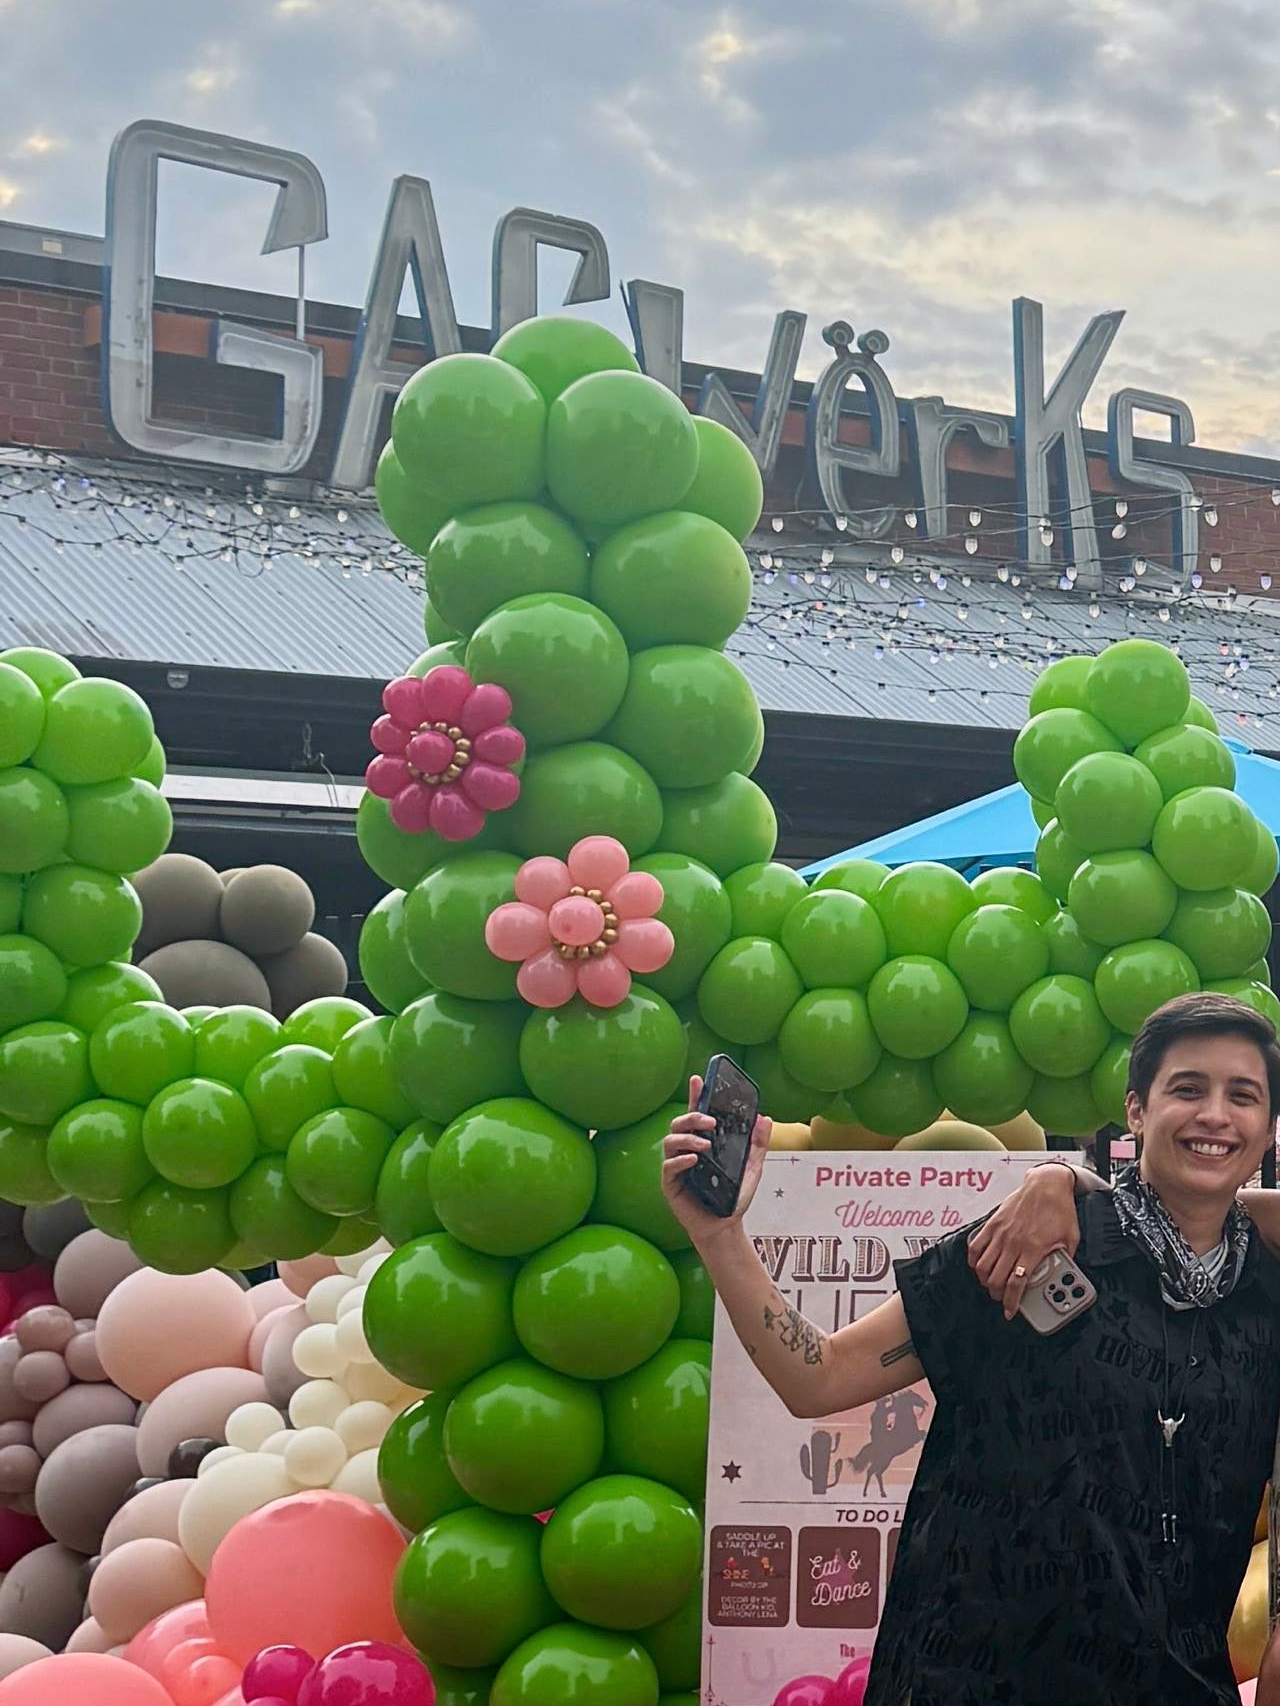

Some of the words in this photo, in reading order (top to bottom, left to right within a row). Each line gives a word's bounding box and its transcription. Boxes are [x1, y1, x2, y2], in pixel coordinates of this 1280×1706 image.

[815, 1165, 911, 1187] Private
[920, 1166, 993, 1192] Party
[834, 1199, 935, 1228] Welcome
[941, 1204, 962, 1227] to
[750, 1235, 890, 1283] WILD
[836, 1509, 858, 1523] TO
[863, 1509, 889, 1523] DO
[809, 1555, 842, 1580] Eat
[848, 1550, 861, 1570] &
[811, 1581, 872, 1607] Dance
